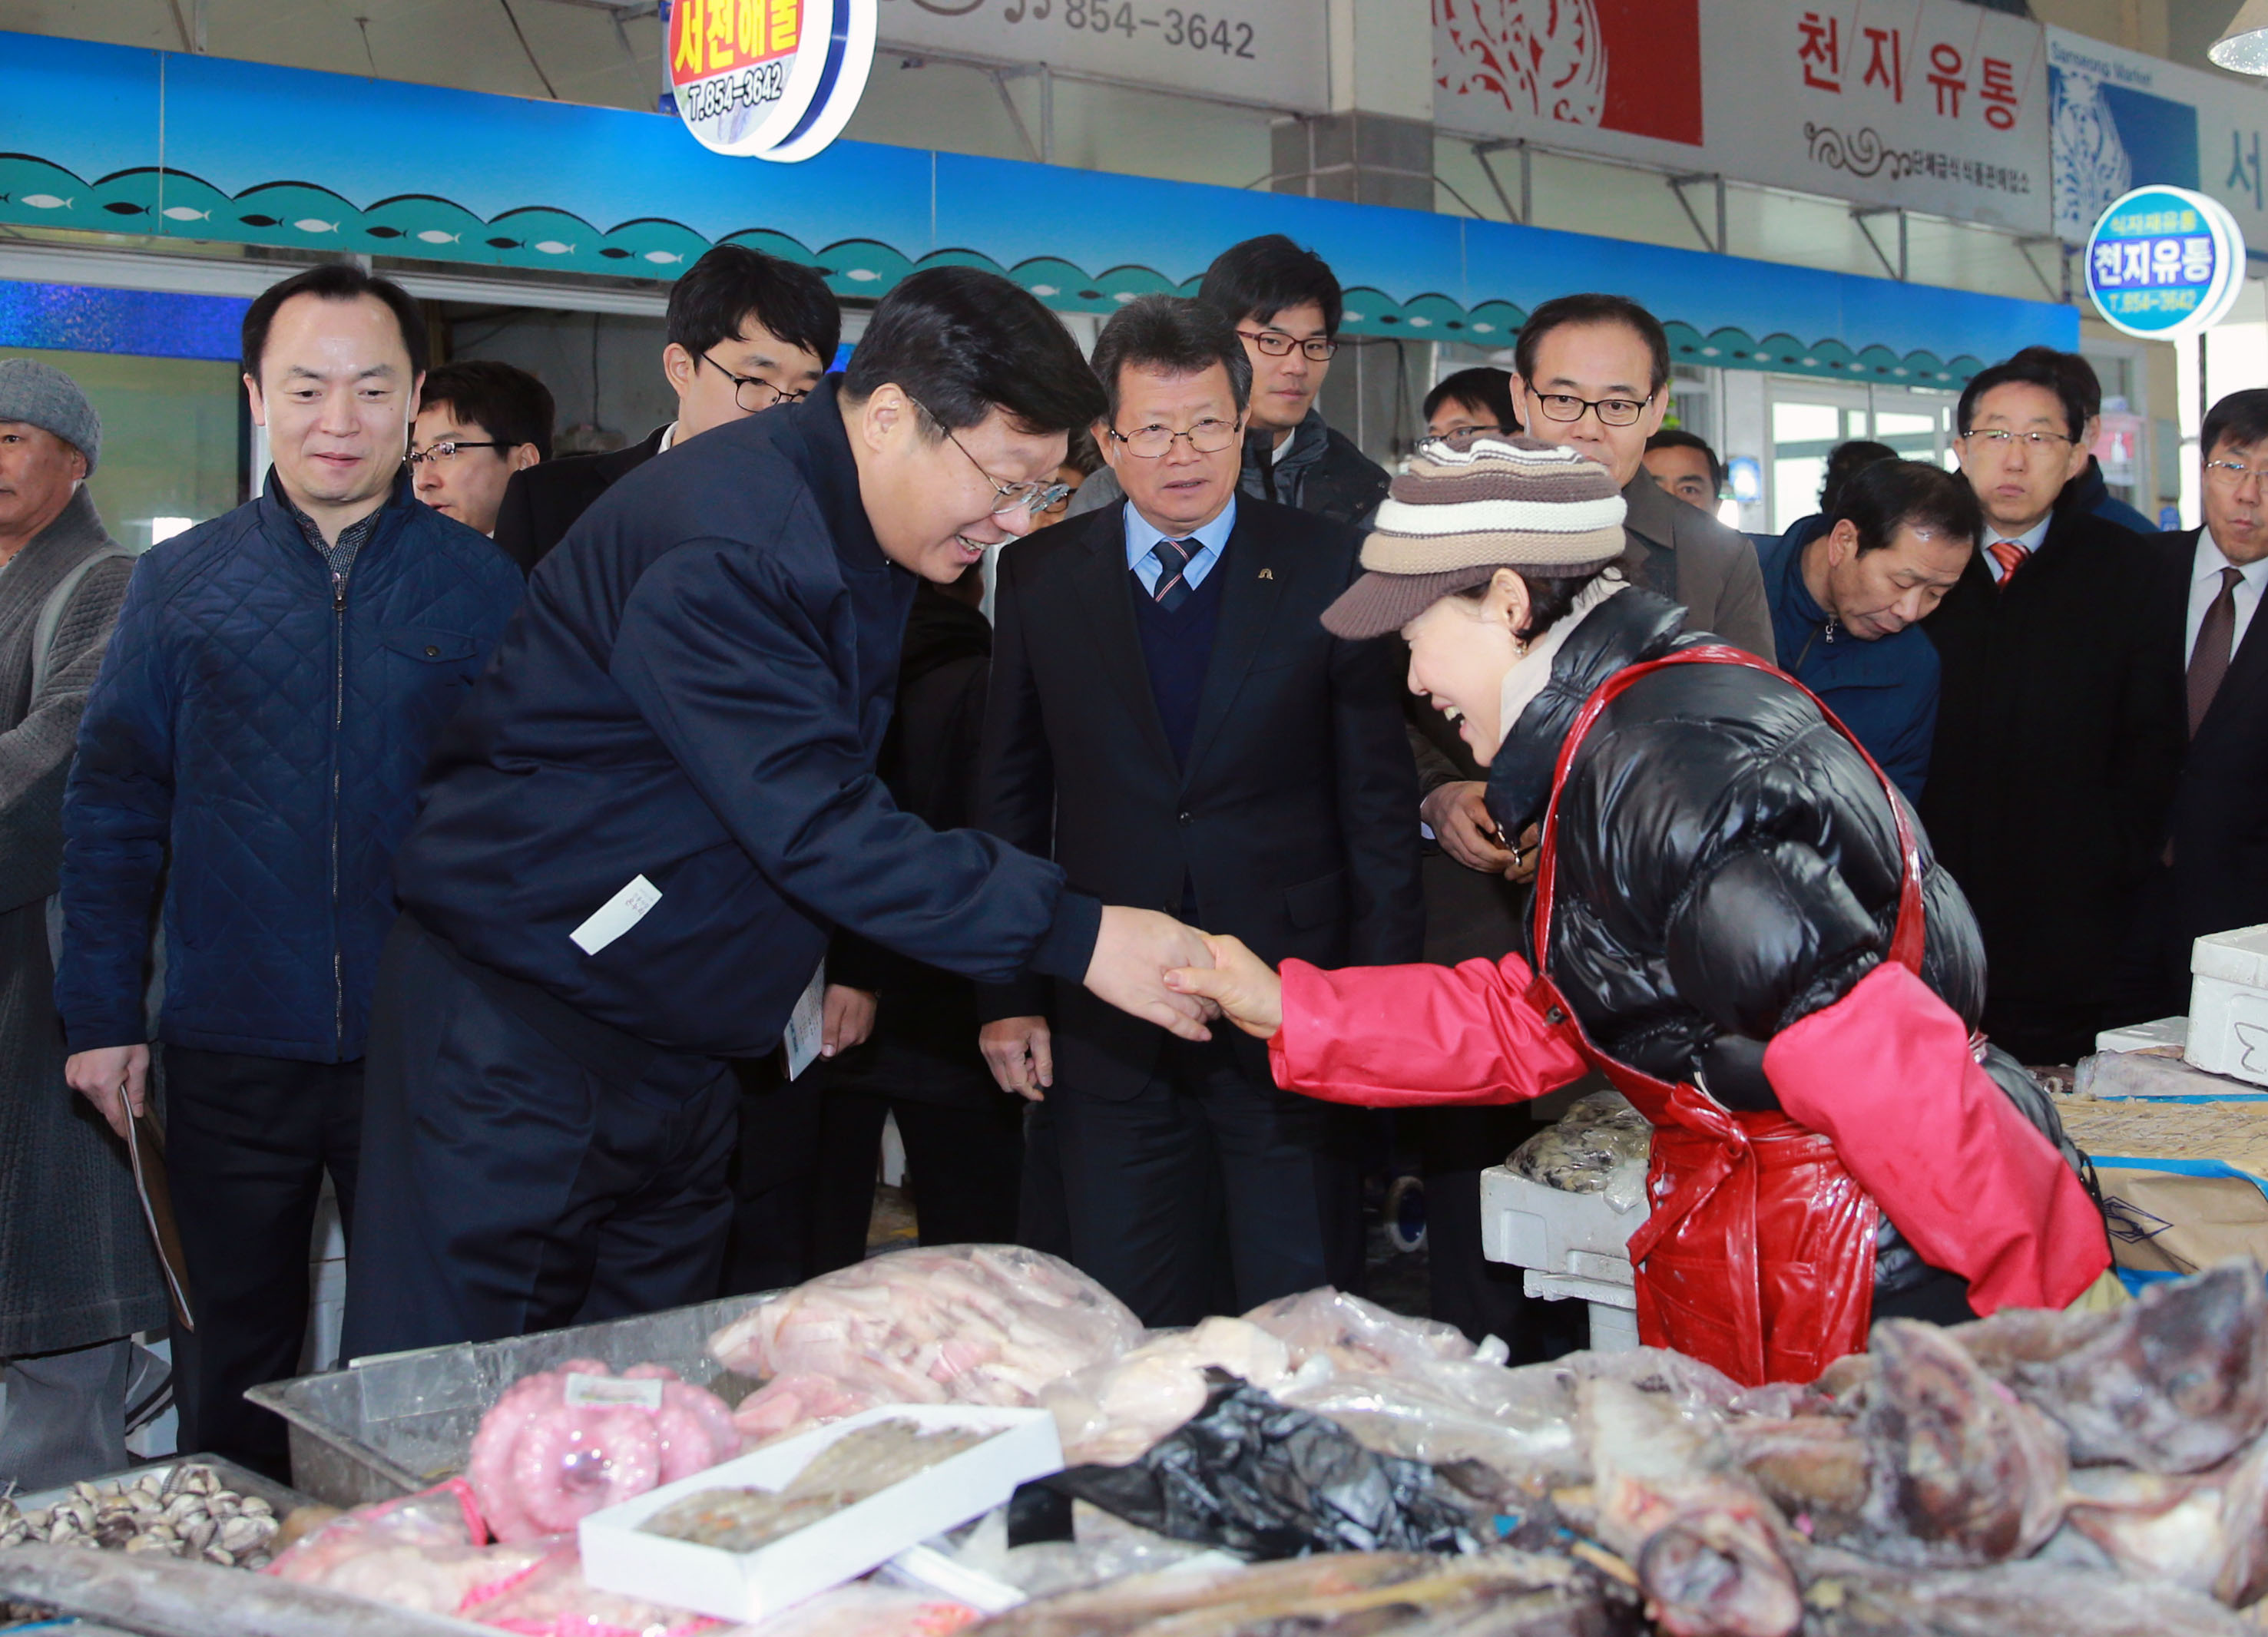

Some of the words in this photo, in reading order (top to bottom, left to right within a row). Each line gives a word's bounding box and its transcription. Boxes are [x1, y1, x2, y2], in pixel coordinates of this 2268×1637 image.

[1065, 0, 1256, 60] 854-3642
[688, 61, 783, 121] T.854-3642
[1798, 12, 2018, 131] 천지유통
[2094, 237, 2213, 286] 천지유통
